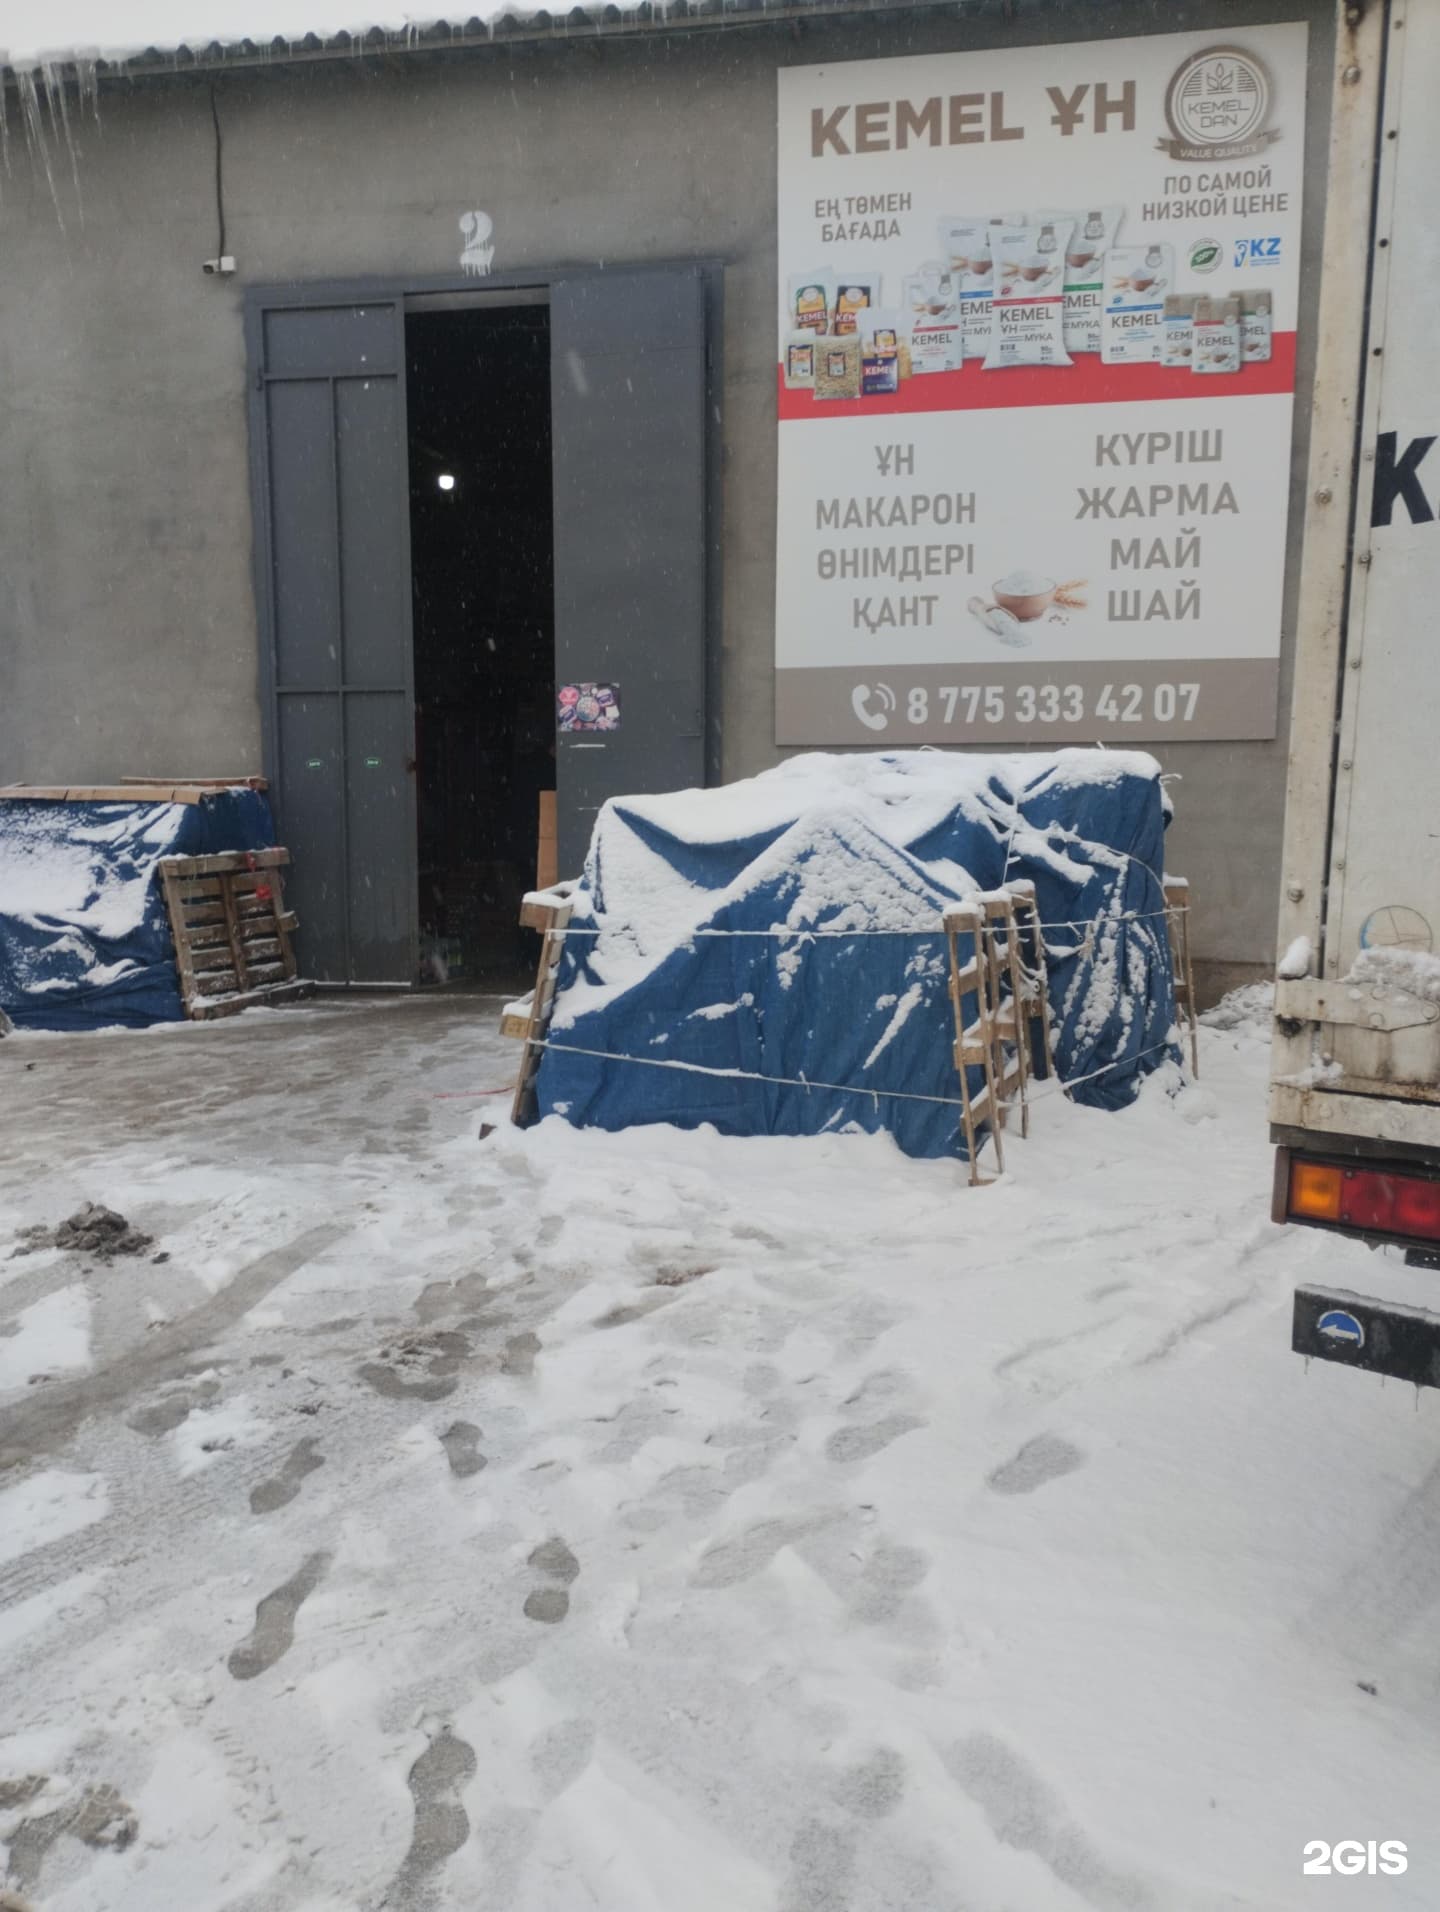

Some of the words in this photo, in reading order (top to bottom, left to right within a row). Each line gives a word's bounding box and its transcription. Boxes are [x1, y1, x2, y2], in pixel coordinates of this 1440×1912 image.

[811, 91, 1024, 158] KEMEL
[1045, 80, 1136, 136] ҰН
[1188, 100, 1249, 115] KEMEL
[1200, 115, 1238, 128] DAN
[1164, 176, 1191, 195] ПО
[1197, 165, 1272, 193] САМОЙ
[815, 199, 840, 219] ЕҢ
[844, 192, 912, 215] ТӨМЕН
[1142, 193, 1227, 222] НИЗКОЙ
[1233, 193, 1289, 218] ЦЕНЕ
[459, 211, 495, 270] 2
[821, 219, 901, 242] БАҒАДА
[1250, 237, 1281, 257] KZ
[1000, 306, 1055, 323] KEMEL
[1111, 313, 1162, 329] KEMEL
[911, 333, 953, 346] KEMEL
[1024, 333, 1054, 343] МУКА
[1197, 336, 1235, 347] KEMEL
[875, 444, 915, 477] ҰН
[1095, 429, 1224, 467] КҮРІШ
[1370, 430, 1440, 528] K
[815, 493, 976, 530] МАКАРОН
[1075, 482, 1240, 520] ЖАРМА
[817, 544, 974, 582] ӨНІМДЕРІ
[1110, 527, 1201, 570] МАЙ
[853, 595, 940, 634] ҚАНТ
[1107, 579, 1201, 622] ШАЙ
[907, 686, 929, 724] 8
[938, 686, 1005, 724] 775
[1015, 685, 1084, 722] 333
[1094, 683, 1143, 722] 42
[1153, 683, 1201, 722] 07
